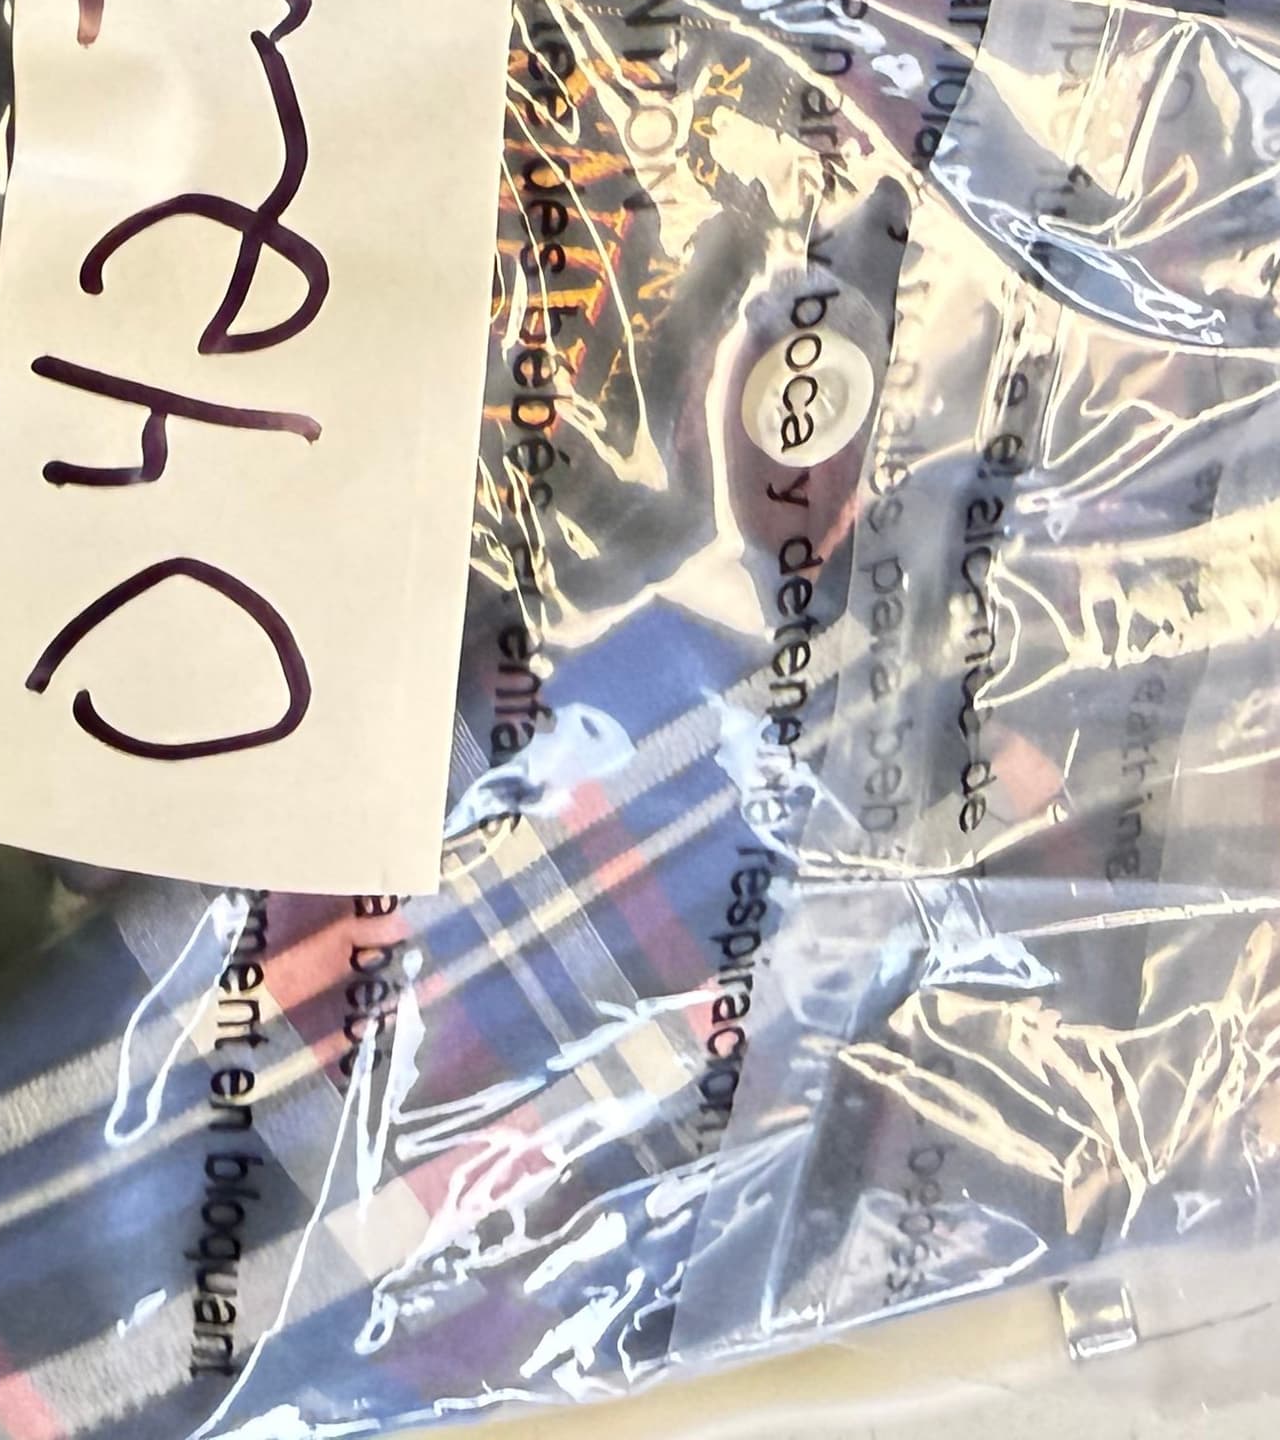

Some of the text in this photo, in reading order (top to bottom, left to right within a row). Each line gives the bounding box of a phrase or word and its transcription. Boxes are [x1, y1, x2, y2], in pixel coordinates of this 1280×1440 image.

[779, 290, 840, 453] boca
[765, 470, 811, 507] y
[957, 760, 997, 834] de
[205, 1068, 256, 1133] en
[182, 1151, 261, 1380] bloquant
